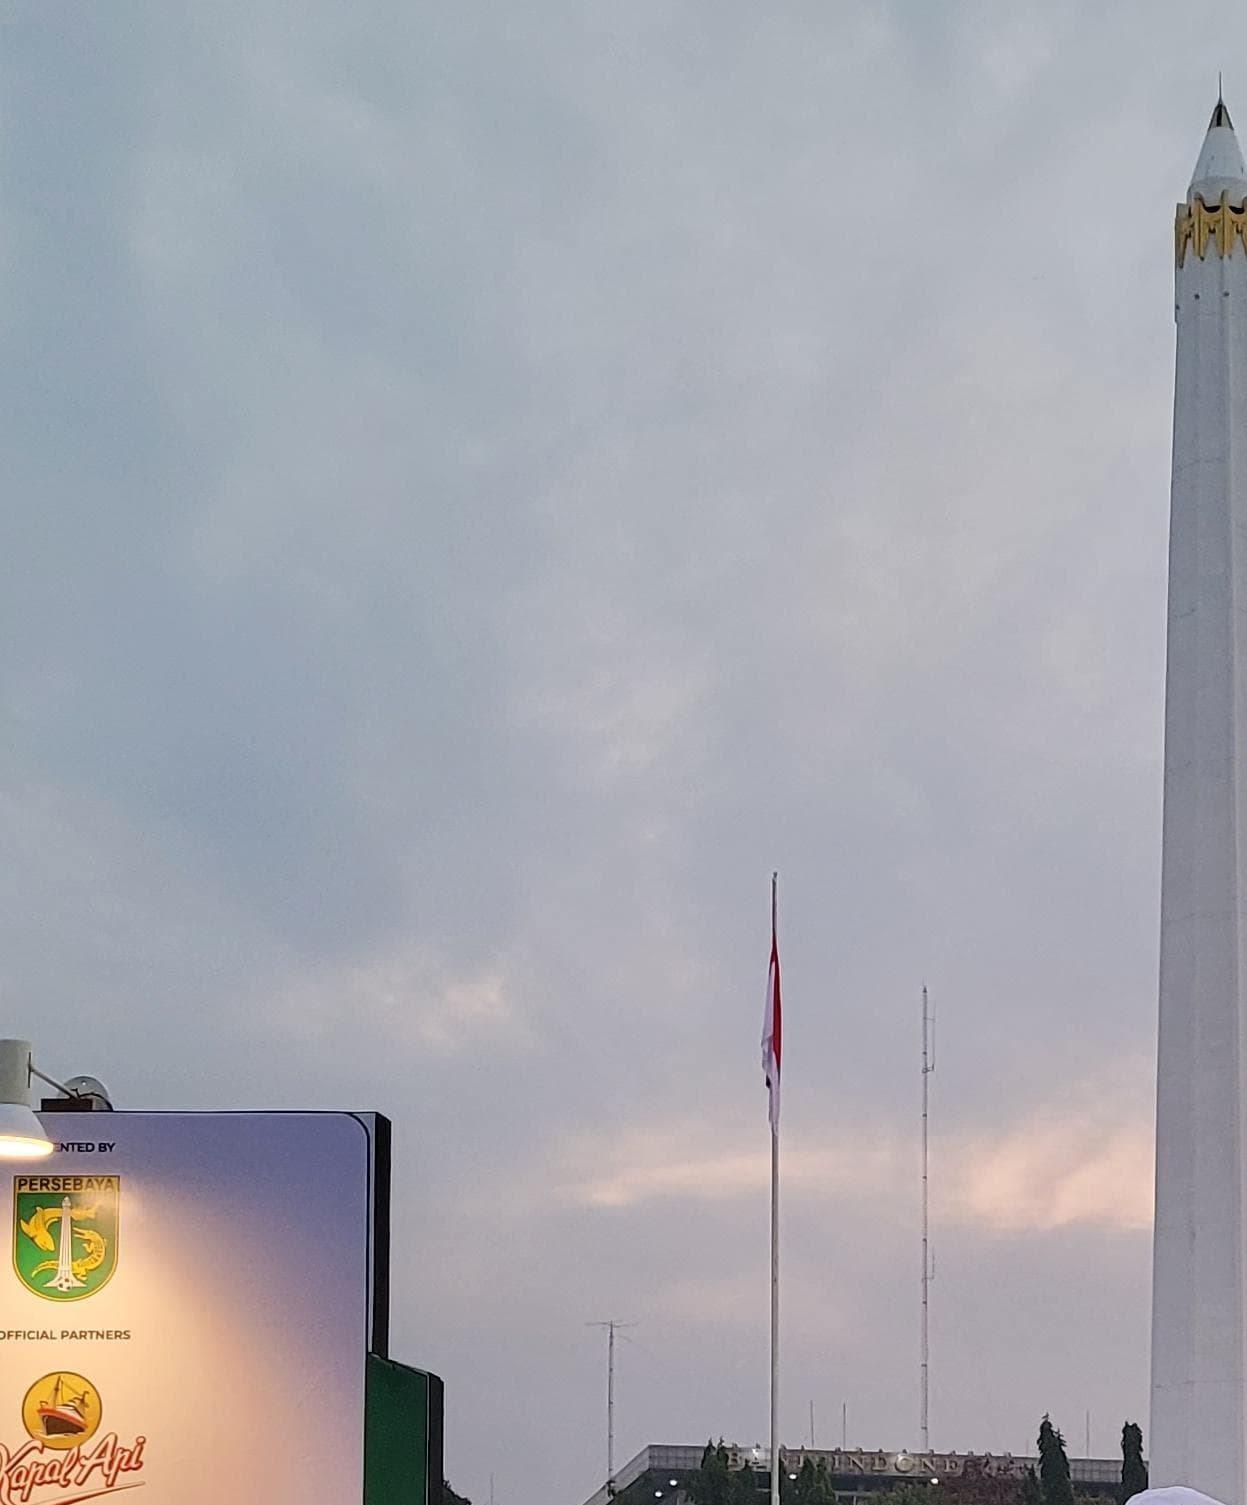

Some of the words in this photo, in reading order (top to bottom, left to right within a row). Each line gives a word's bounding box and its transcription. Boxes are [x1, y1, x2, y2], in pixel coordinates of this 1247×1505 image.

[53, 1142, 95, 1153] ENTED
[98, 1142, 116, 1153] BY
[18, 1178, 116, 1191] PERSEBAYA
[0, 1330, 57, 1340] OFFICIAL
[61, 1330, 131, 1340] PARTNERS
[75, 1432, 146, 1488] Api
